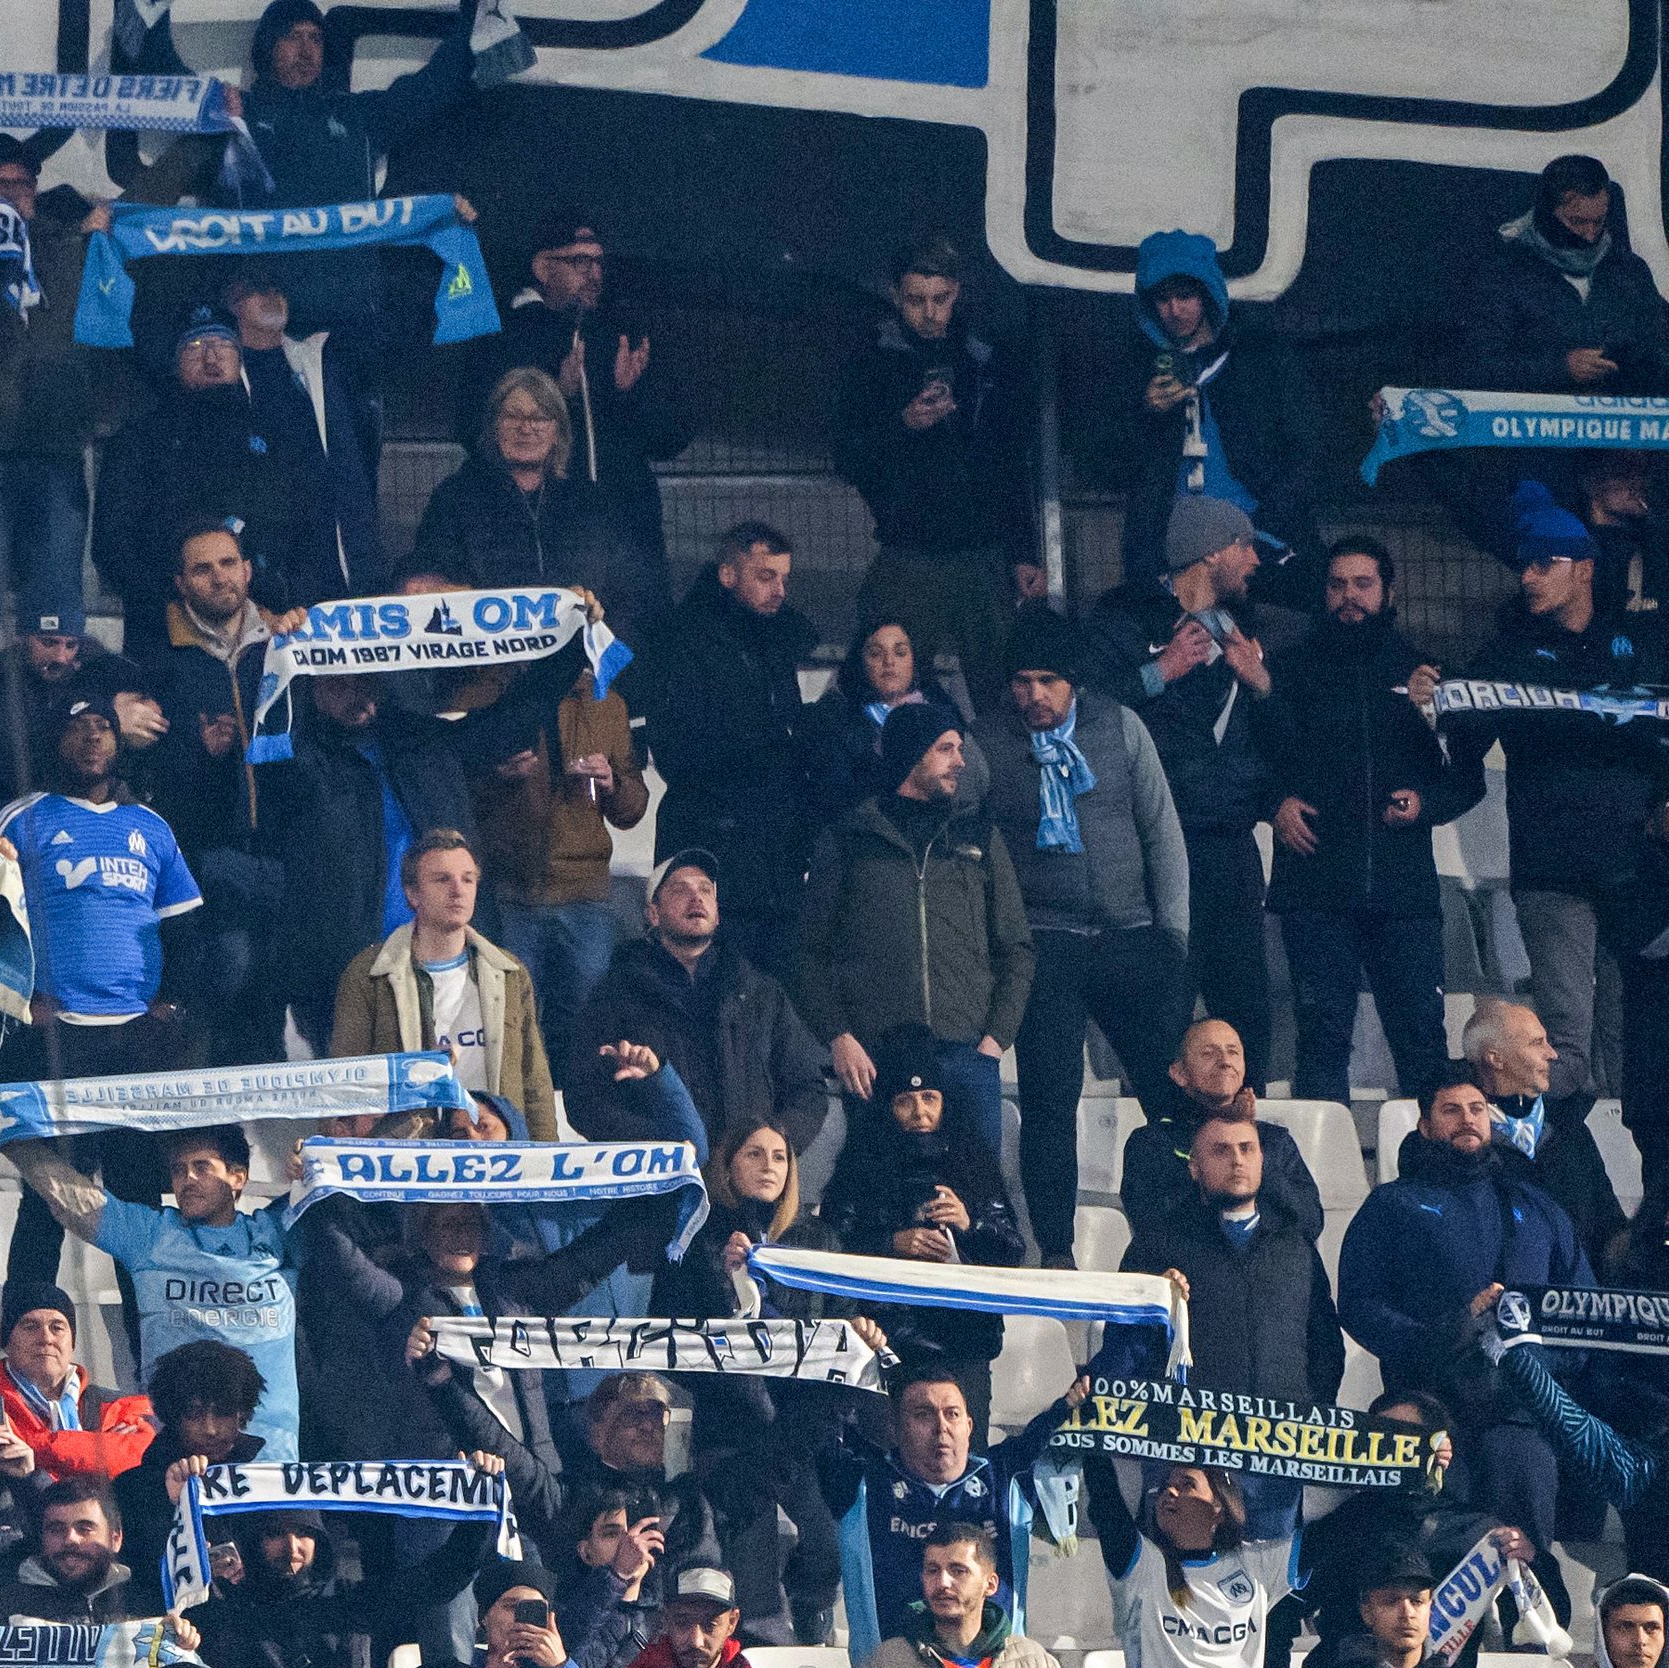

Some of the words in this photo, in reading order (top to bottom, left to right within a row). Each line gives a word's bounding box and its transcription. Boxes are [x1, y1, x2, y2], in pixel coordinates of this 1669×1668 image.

[281, 209, 326, 237] AU
[1492, 415, 1604, 442] OLYMPIQUE
[474, 593, 562, 634] OM
[353, 645, 402, 665] 1987
[407, 639, 489, 661] VIRAGE
[493, 633, 559, 655] NORD
[99, 856, 149, 876] INTER
[101, 872, 149, 892] SPORT
[336, 1152, 523, 1184] ALLEZ
[552, 1145, 685, 1179] L'OM
[1151, 1381, 1355, 1430] MARSEILLAIS
[1178, 1406, 1421, 1468] MARSEILLE
[1103, 1433, 1195, 1463] SOMMES
[1202, 1446, 1245, 1469] LES
[1250, 1450, 1403, 1488] MARSEILLAIS
